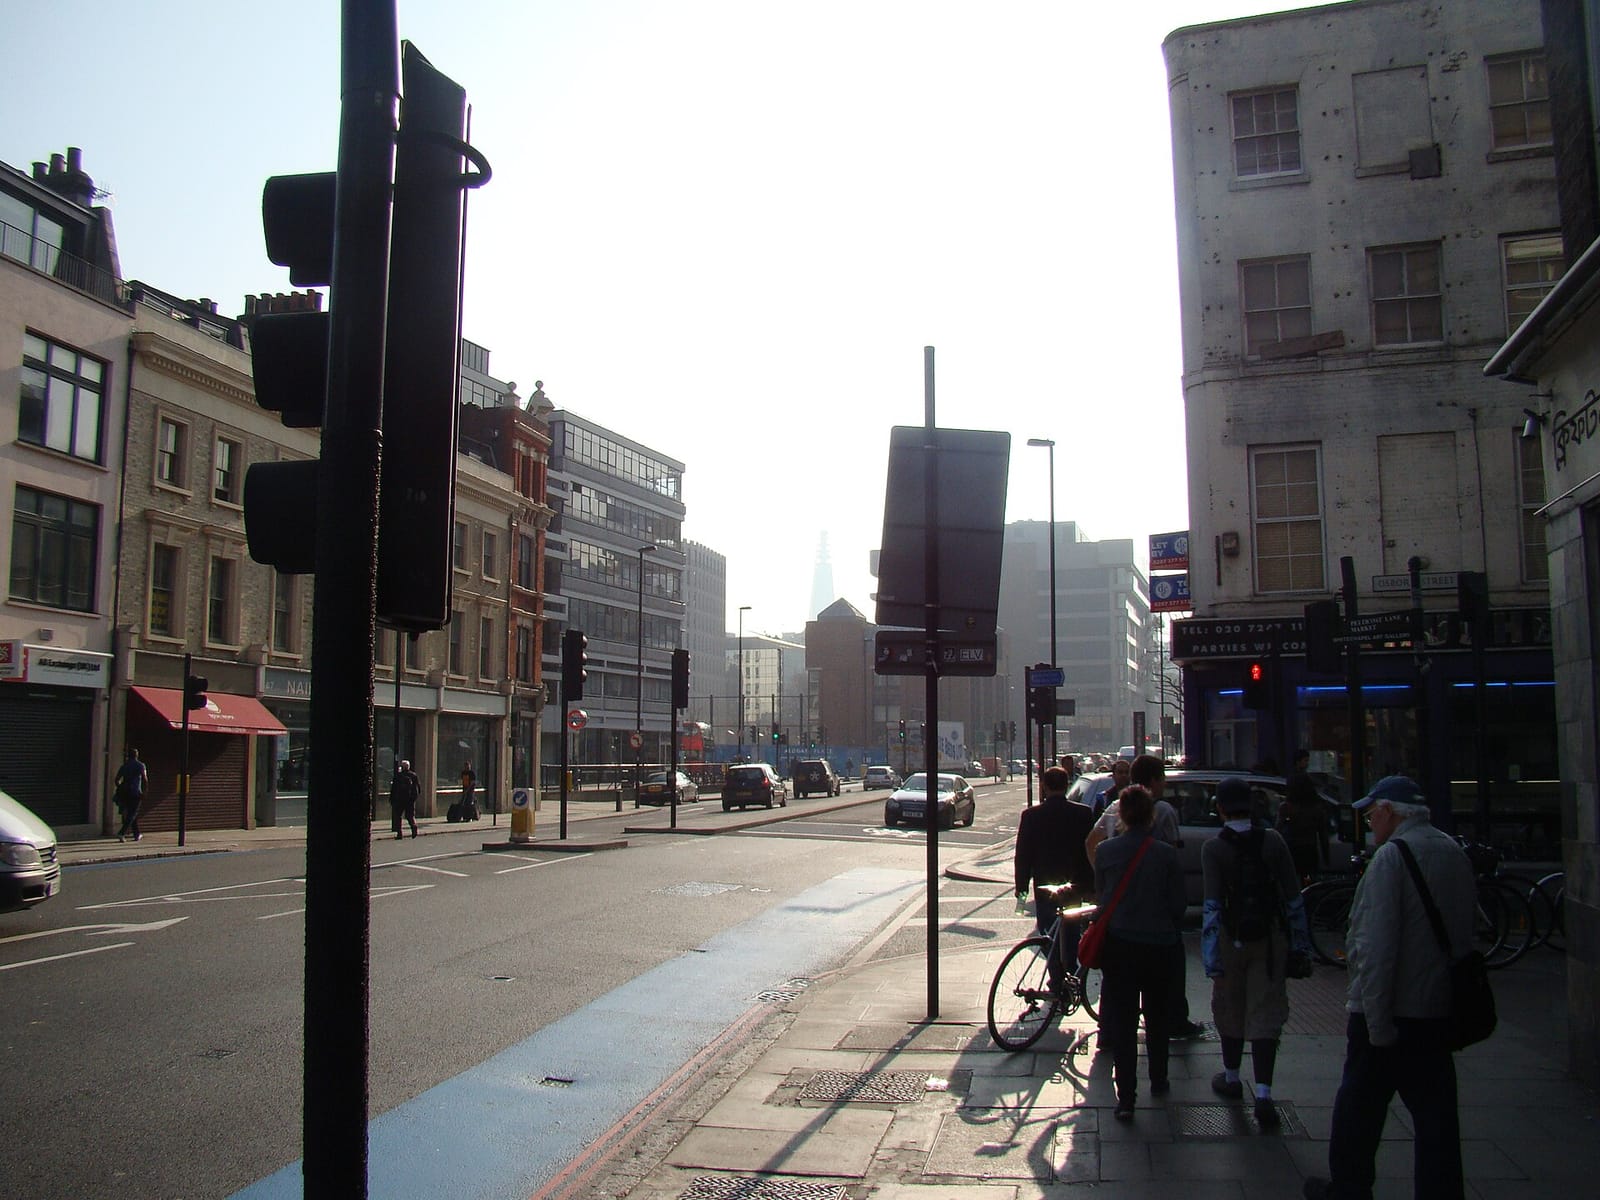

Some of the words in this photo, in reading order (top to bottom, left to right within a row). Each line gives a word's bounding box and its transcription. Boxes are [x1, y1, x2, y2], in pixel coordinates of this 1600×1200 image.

[1378, 577, 1410, 588] OSBOR
[1215, 624, 1241, 633] 020
[1192, 643, 1247, 653] PARTIES
